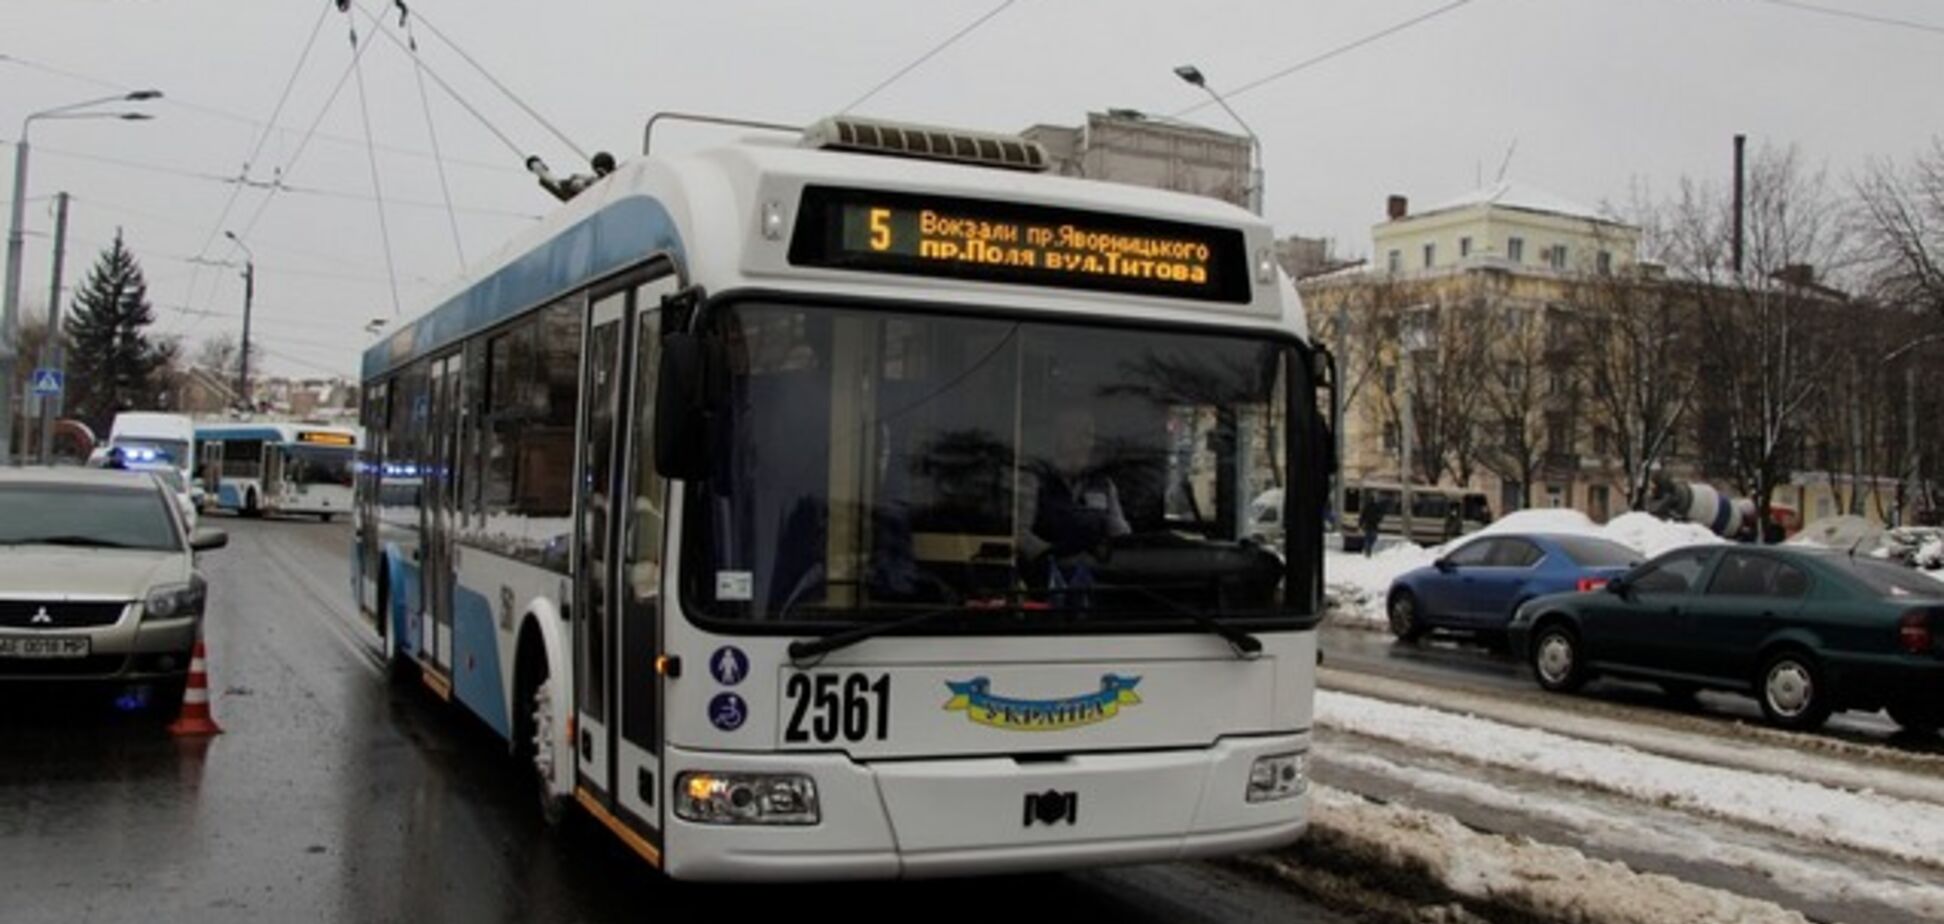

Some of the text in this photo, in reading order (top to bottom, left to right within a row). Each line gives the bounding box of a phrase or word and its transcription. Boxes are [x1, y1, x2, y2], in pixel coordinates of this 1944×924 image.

[869, 208, 891, 251] 5
[919, 239, 1208, 284] пр.Поля вул.Титова
[784, 672, 891, 743] 2561
